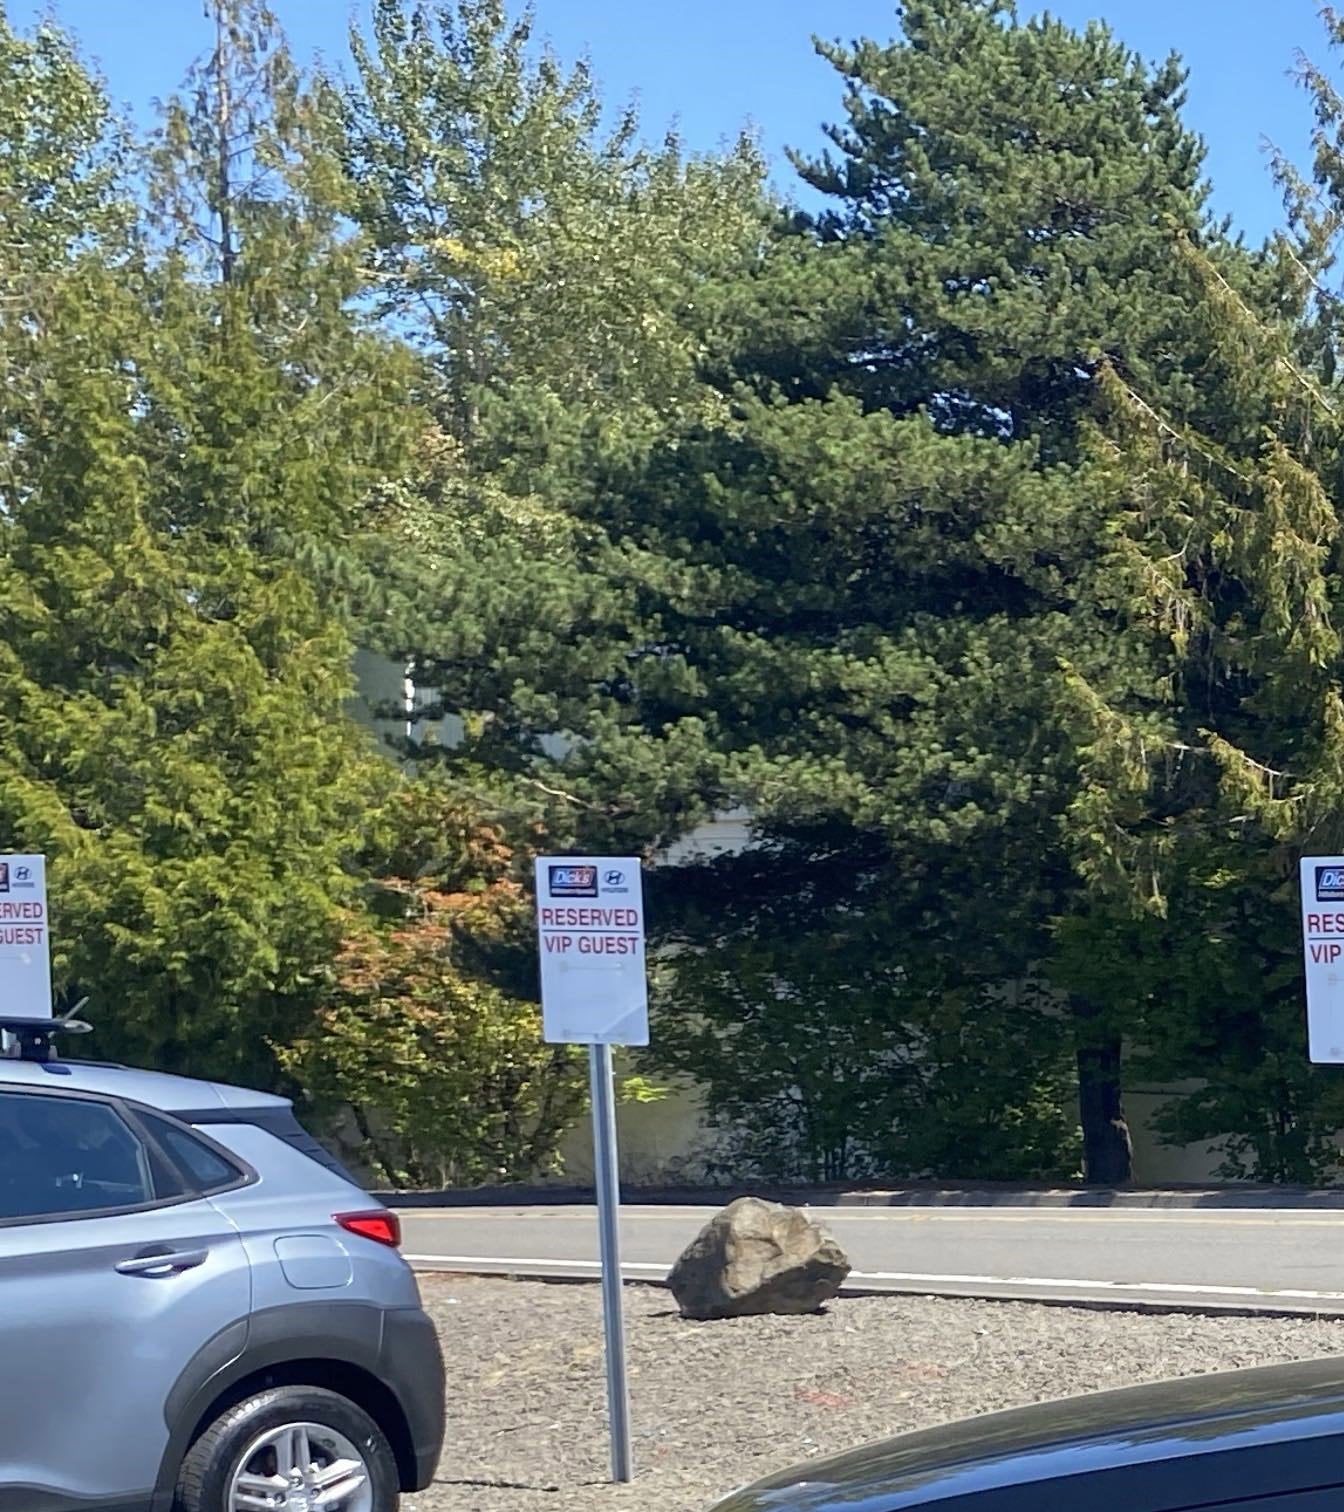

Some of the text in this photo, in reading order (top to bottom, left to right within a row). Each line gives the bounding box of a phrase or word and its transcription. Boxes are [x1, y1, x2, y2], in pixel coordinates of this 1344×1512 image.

[0, 902, 43, 919] RVED
[542, 908, 639, 927] RESERVED
[544, 935, 639, 955] VIP GUEST
[1310, 944, 1341, 964] VIP
